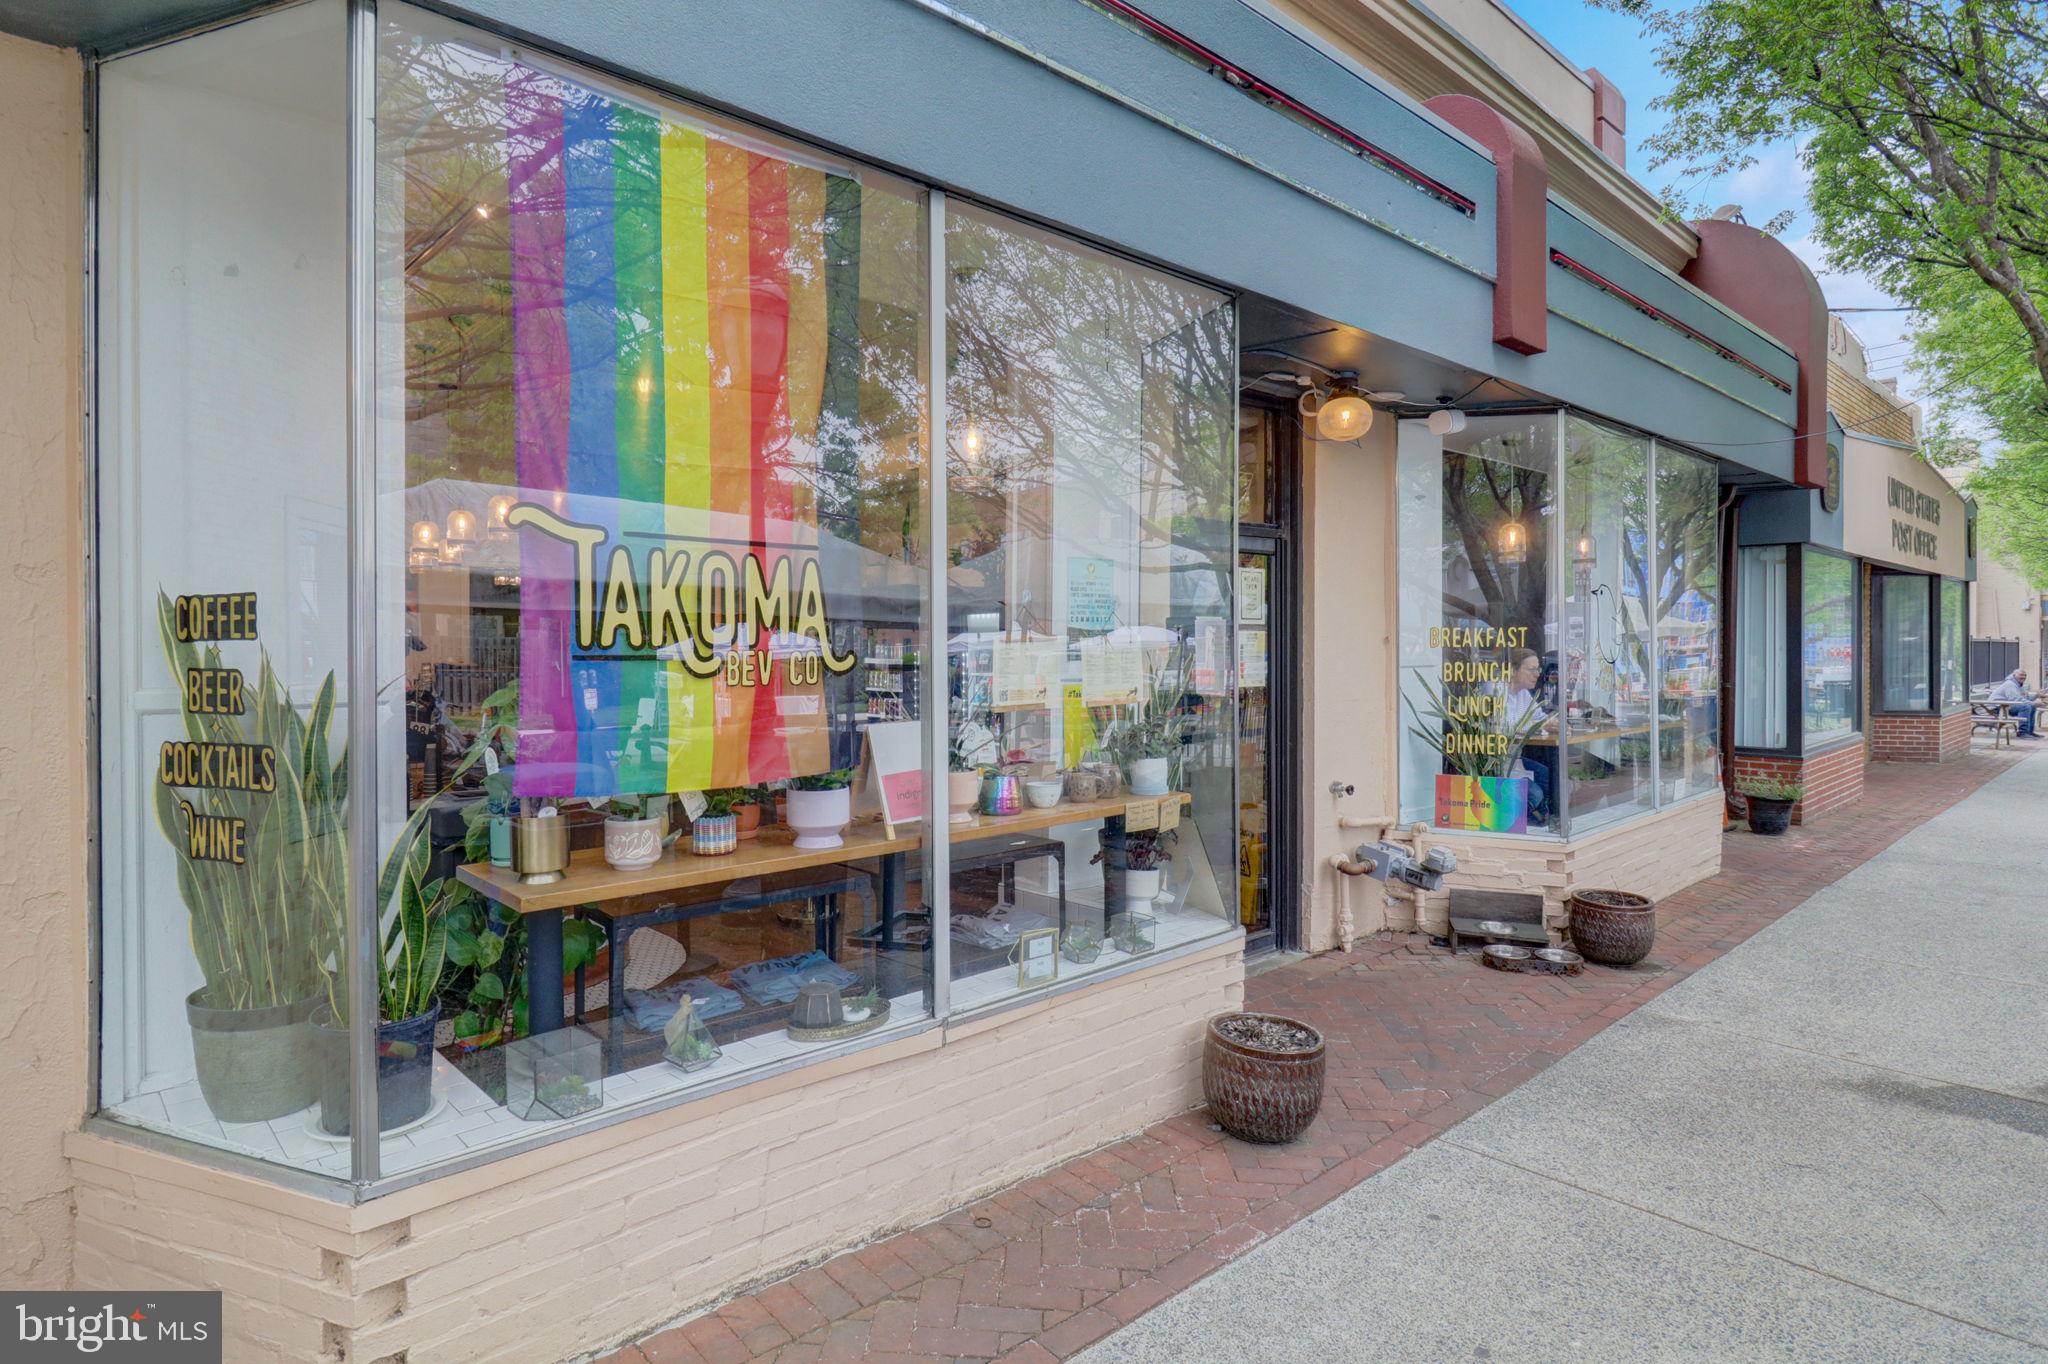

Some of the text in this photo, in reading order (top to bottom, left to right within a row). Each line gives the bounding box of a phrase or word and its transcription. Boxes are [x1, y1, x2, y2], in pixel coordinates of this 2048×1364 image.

[1887, 476, 1941, 526] UNITED STATES
[1892, 519, 1937, 560] POST OFFICE
[506, 503, 856, 677] TAKOMA
[174, 593, 257, 642] COFFEE
[1429, 626, 1528, 649] BREAKFAST
[727, 650, 820, 687] BEV CO
[1443, 661, 1511, 683] BRUNCH
[187, 668, 245, 715] BEER
[1447, 696, 1506, 722] LUNCH
[1446, 733, 1508, 755] DINNER
[160, 741, 277, 794] COCKTAILS
[1439, 798, 1491, 809] Takoma Pride
[180, 800, 246, 865] WINE
